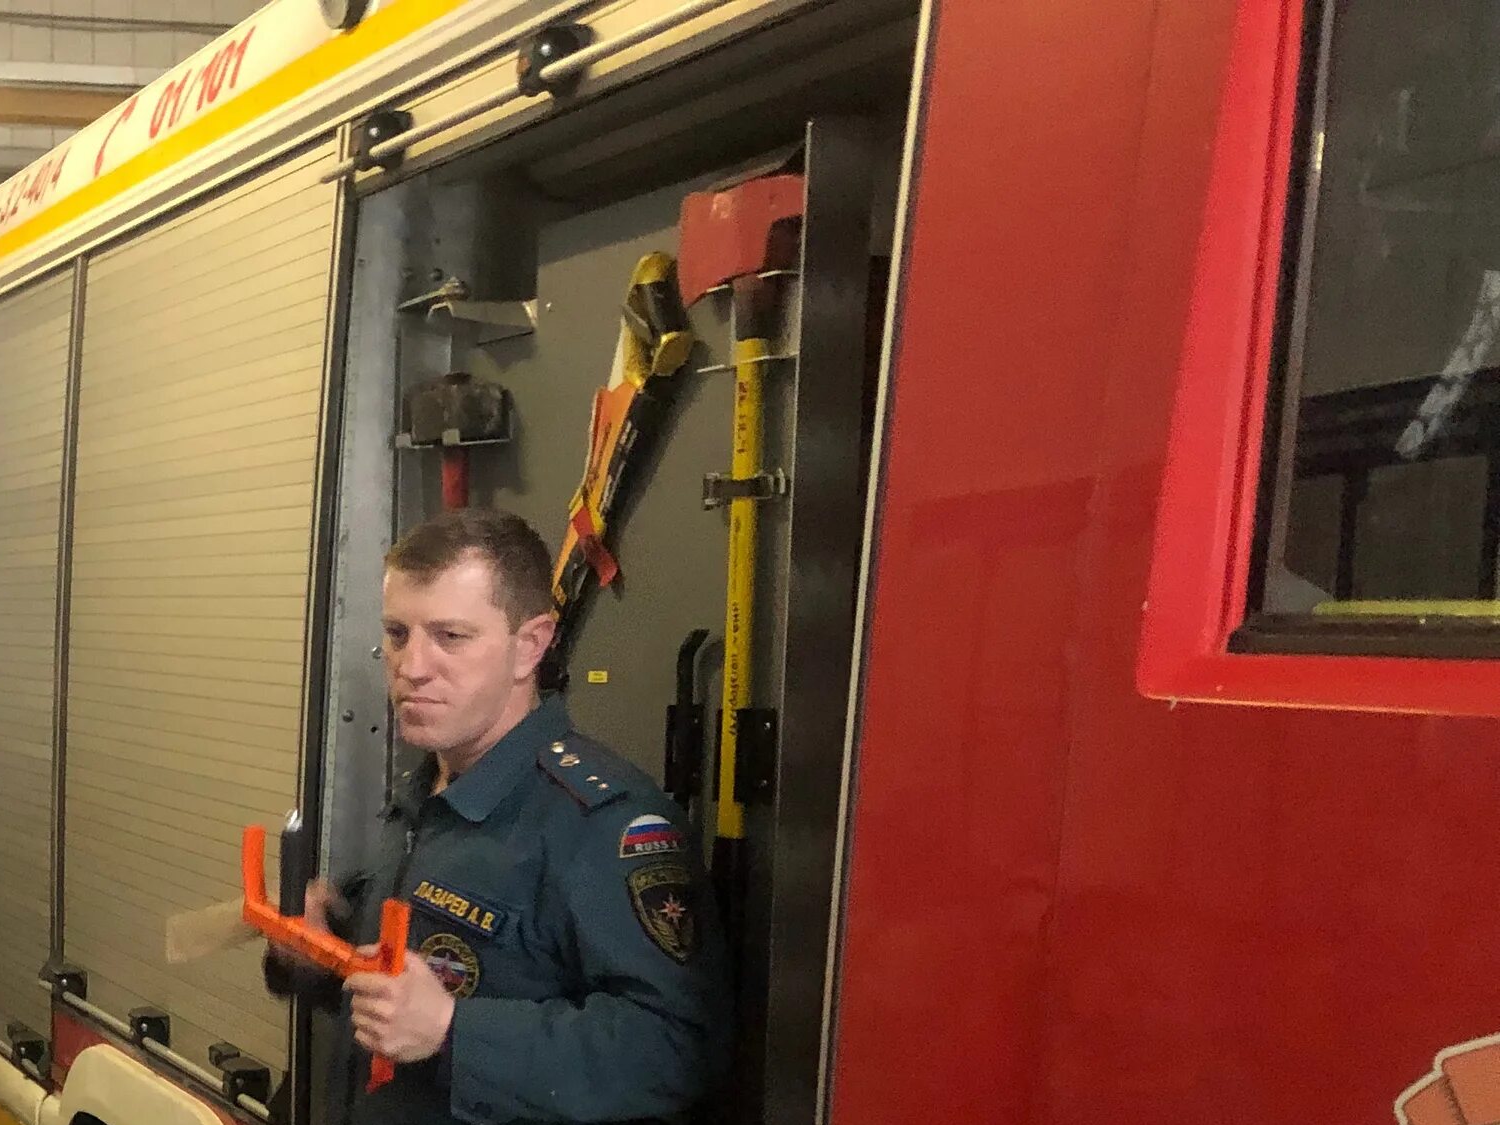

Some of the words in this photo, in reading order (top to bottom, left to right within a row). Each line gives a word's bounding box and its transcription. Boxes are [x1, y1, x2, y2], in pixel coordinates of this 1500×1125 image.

[149, 26, 256, 139] 01/101
[635, 840, 678, 853] RUSSA
[413, 881, 470, 917] ЛАЗАРЕВ
